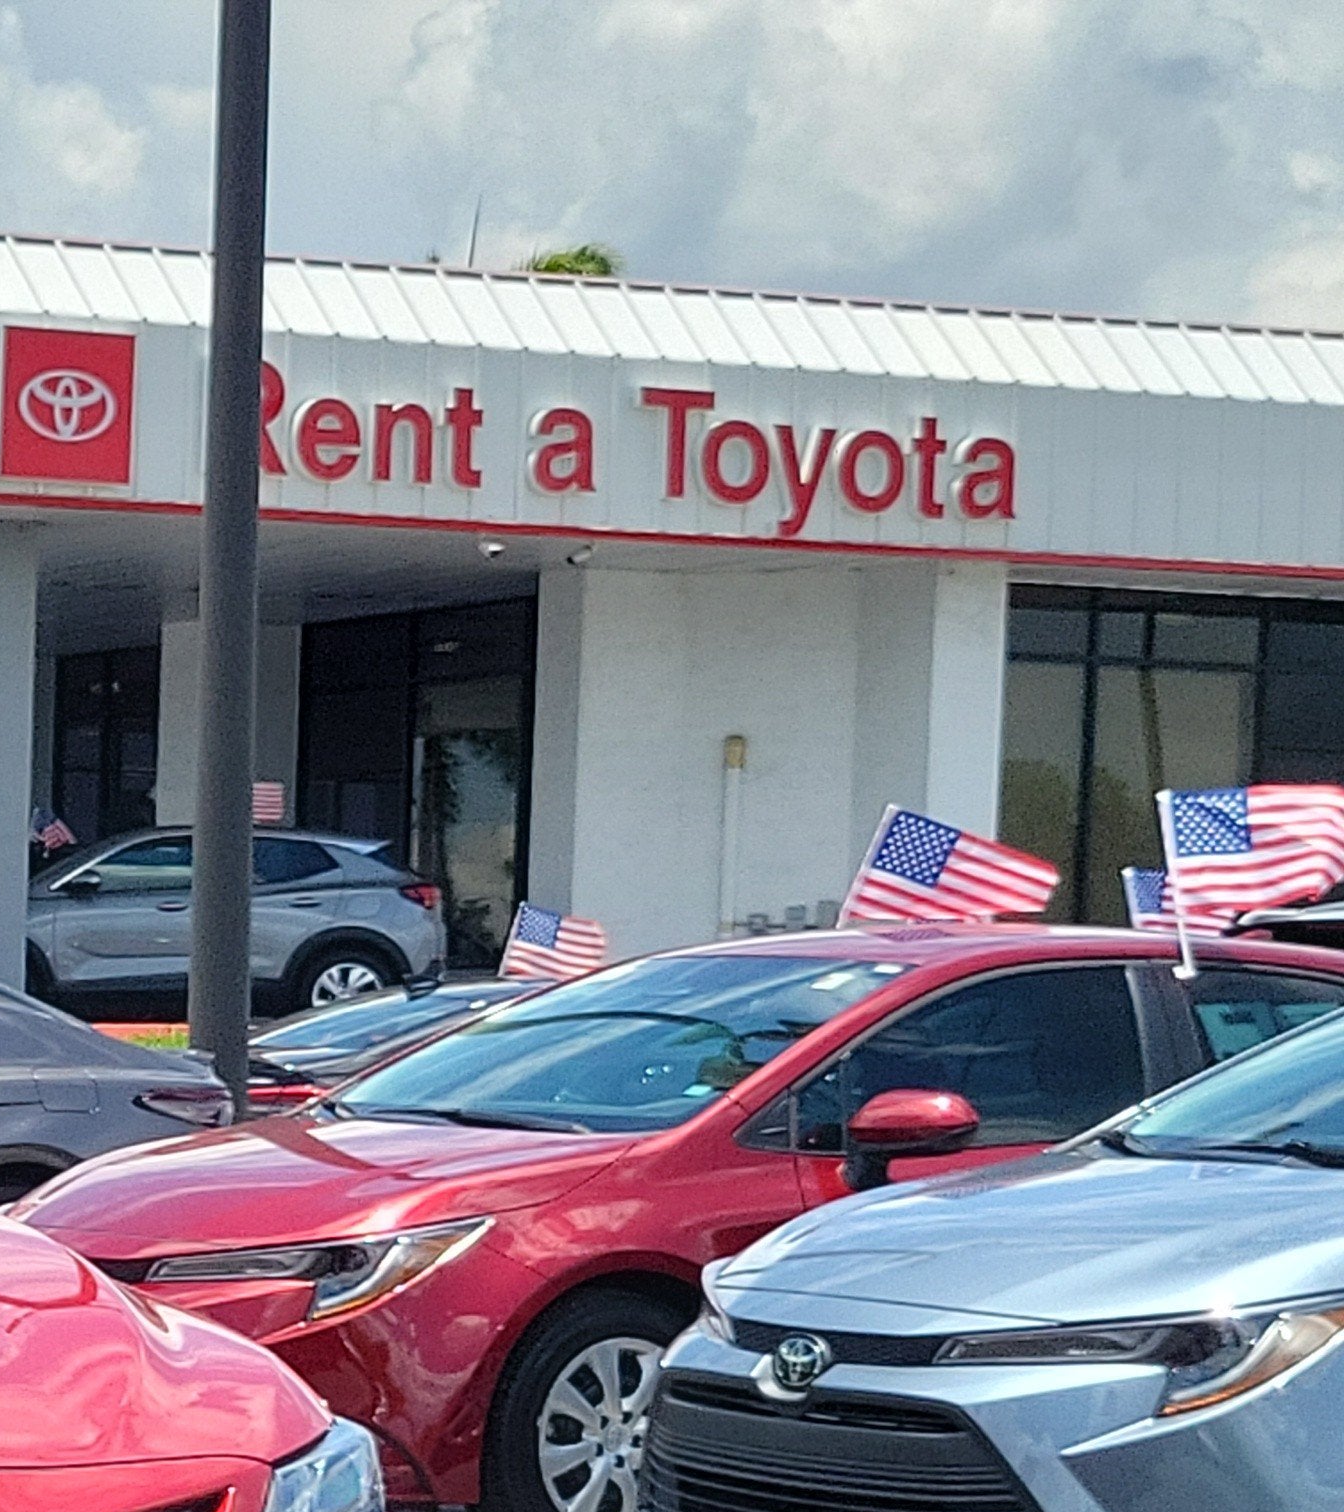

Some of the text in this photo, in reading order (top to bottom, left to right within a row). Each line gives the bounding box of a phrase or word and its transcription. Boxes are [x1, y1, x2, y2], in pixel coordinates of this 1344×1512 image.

[260, 360, 1017, 537] Rent a Toyota
